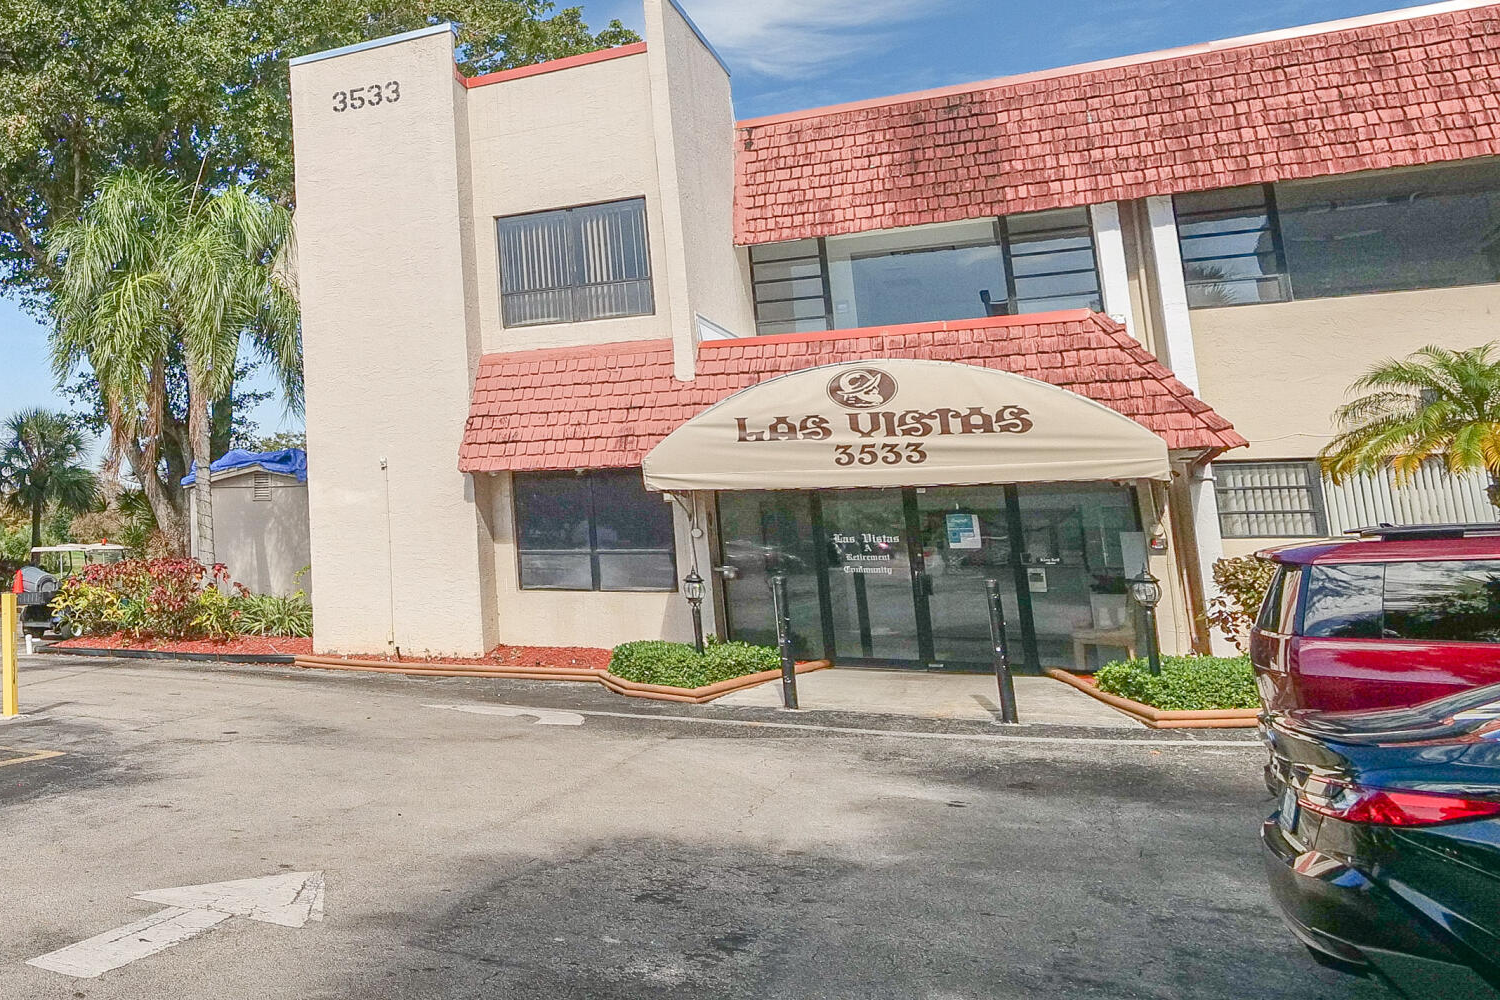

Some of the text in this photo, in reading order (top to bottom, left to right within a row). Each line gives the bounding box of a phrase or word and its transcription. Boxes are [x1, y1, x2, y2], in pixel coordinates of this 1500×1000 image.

[332, 80, 400, 112] 3533
[734, 405, 1034, 442] LAS VISTAS
[834, 442, 928, 466] 3533
[833, 533, 900, 544] Las Vistas
[864, 544, 872, 552] A
[845, 553, 890, 561] Retirement
[843, 565, 893, 575] Community
